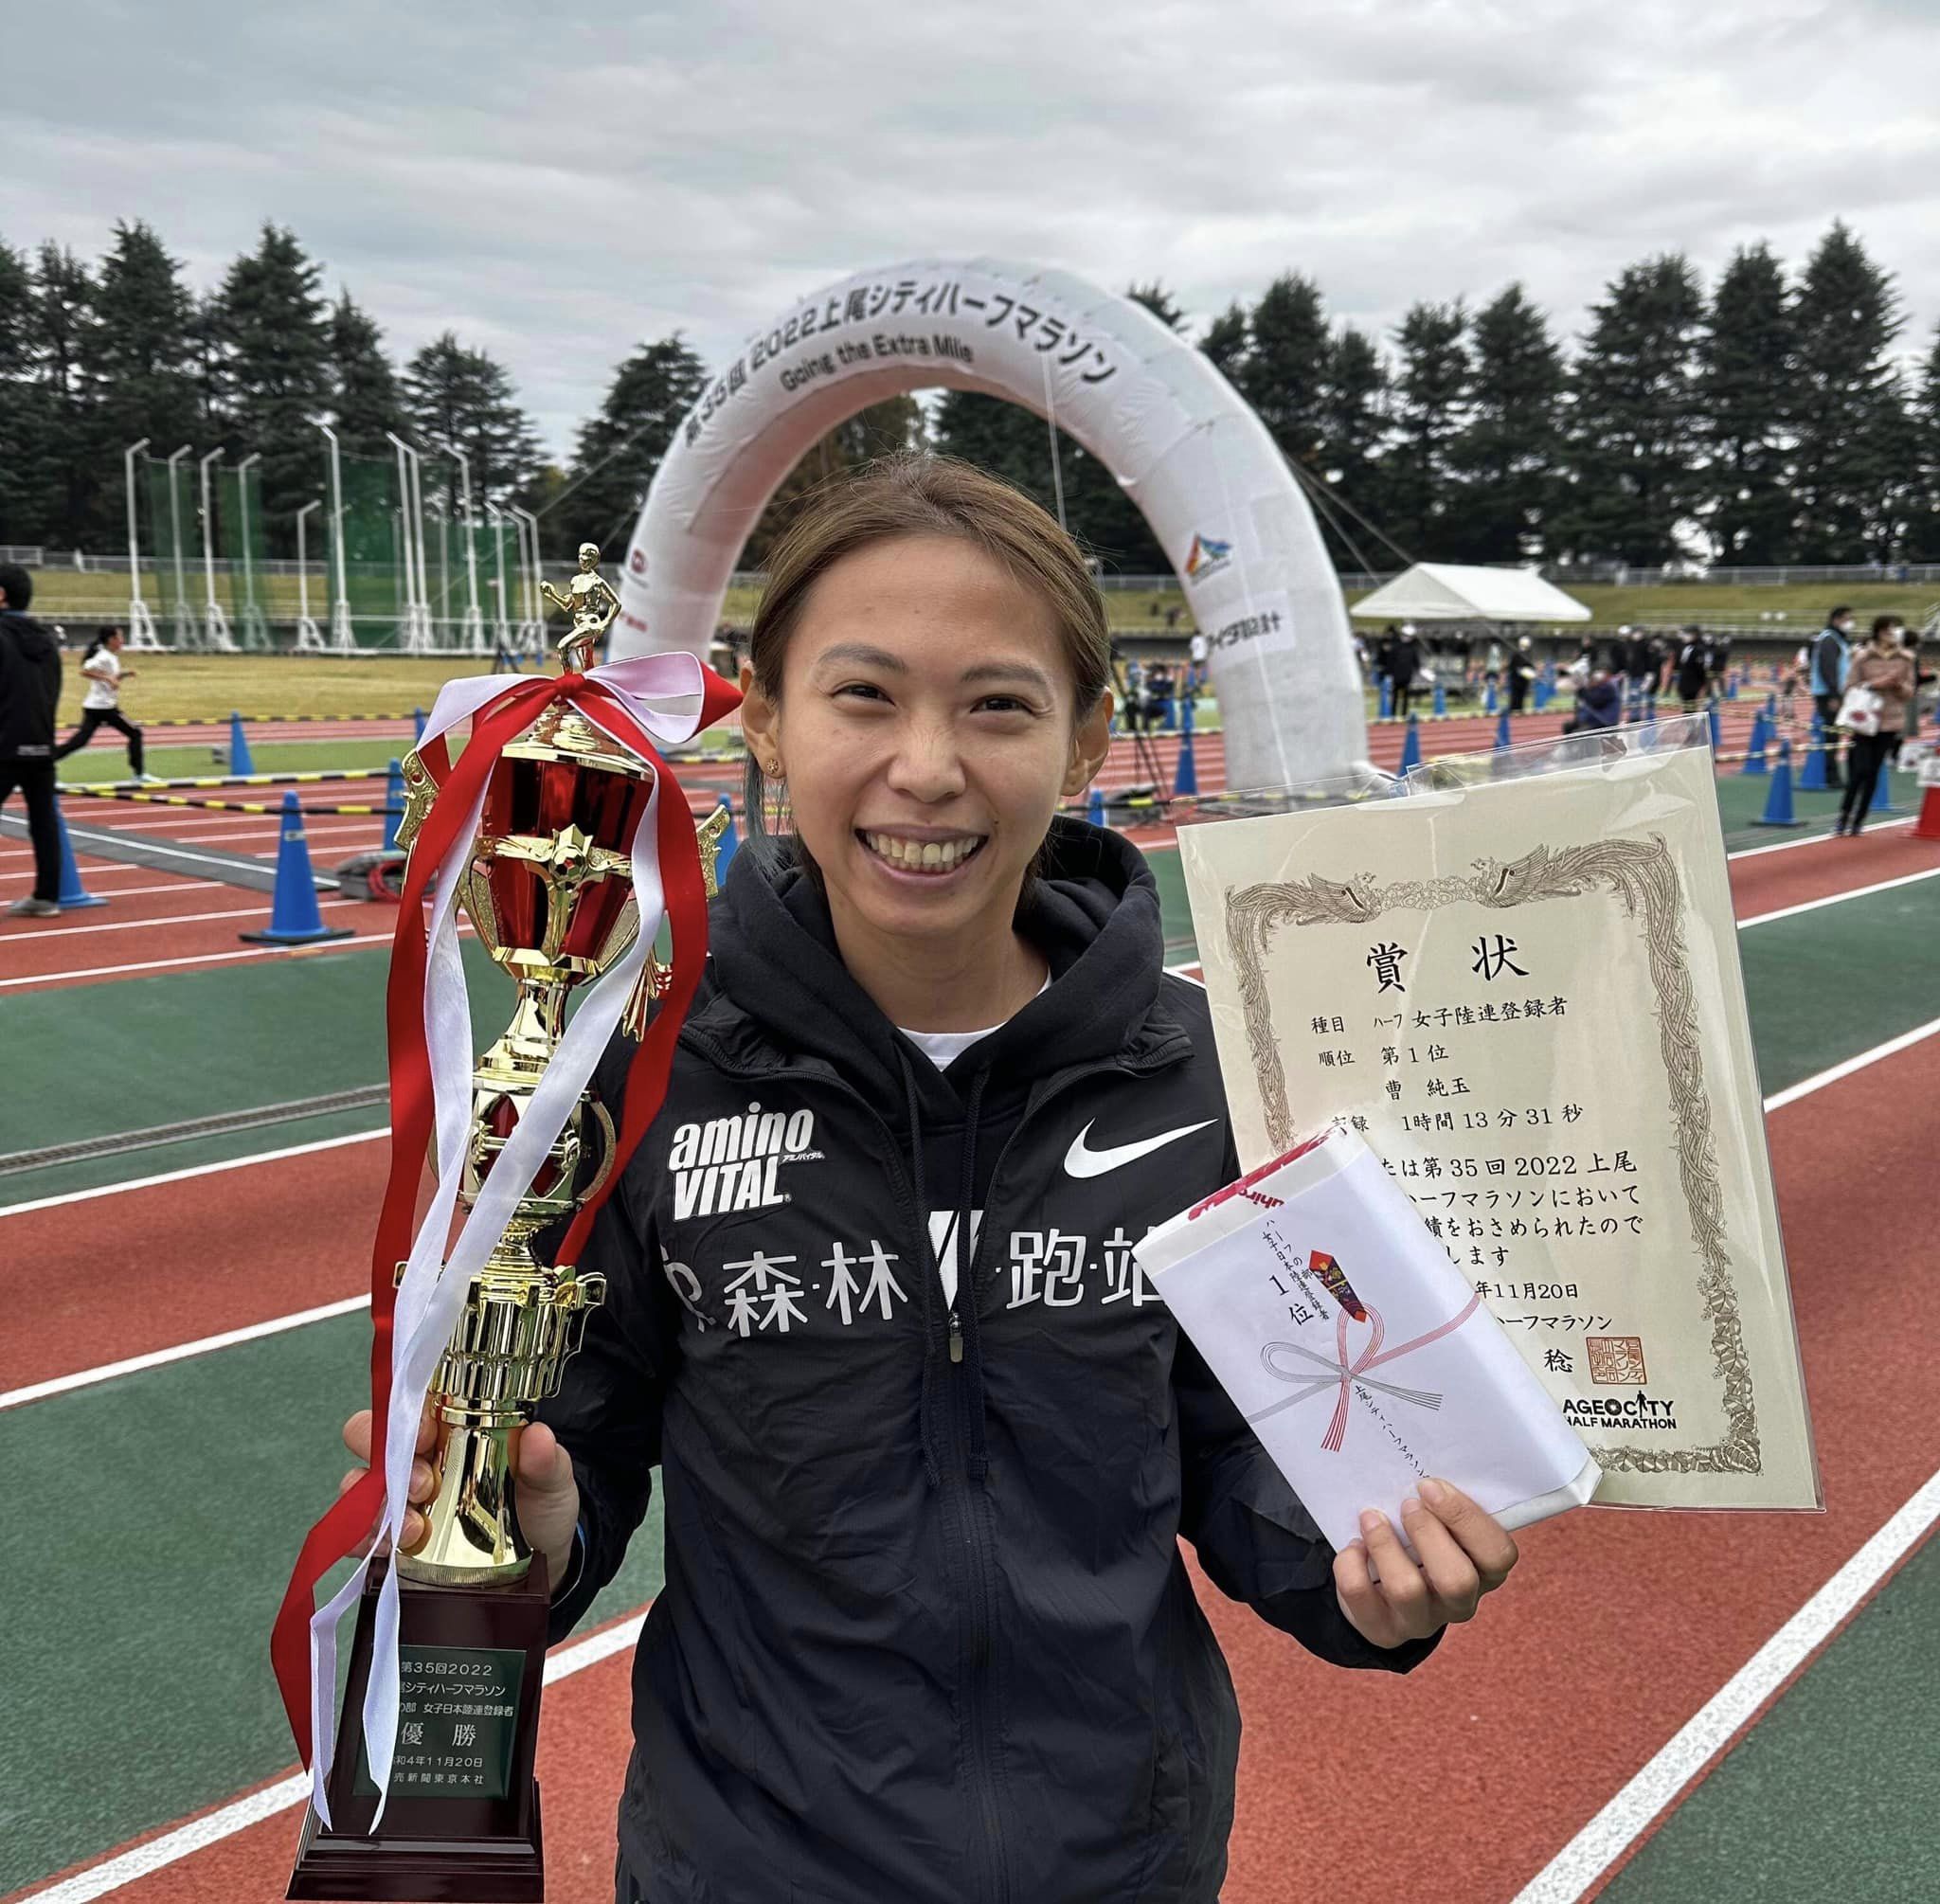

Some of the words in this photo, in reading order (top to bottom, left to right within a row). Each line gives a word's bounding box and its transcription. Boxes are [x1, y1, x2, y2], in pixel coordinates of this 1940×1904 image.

[780, 353, 837, 391] Going
[837, 340, 872, 365] the
[871, 334, 929, 357] Extra
[931, 335, 974, 364] Mile
[1311, 1016, 1345, 1034] 種目
[1411, 996, 1568, 1028] 女子陸連登録者
[1318, 1049, 1356, 1067] 順位
[1385, 1080, 1402, 1101] 曹
[1426, 1077, 1471, 1098] 純玉
[669, 1102, 815, 1171] amino
[1424, 1215, 1644, 1238] 績をおさめられたので
[1446, 1246, 1509, 1266] します
[1268, 1275, 1314, 1326] 1位
[1475, 1281, 1578, 1299] 年11月20日
[1543, 1348, 1573, 1374] 稔
[1356, 1385, 1430, 1478] 上尾シティハーフマラソン
[1600, 1417, 1677, 1429] MARATHON
[401, 1662, 493, 1676] 第35回2022
